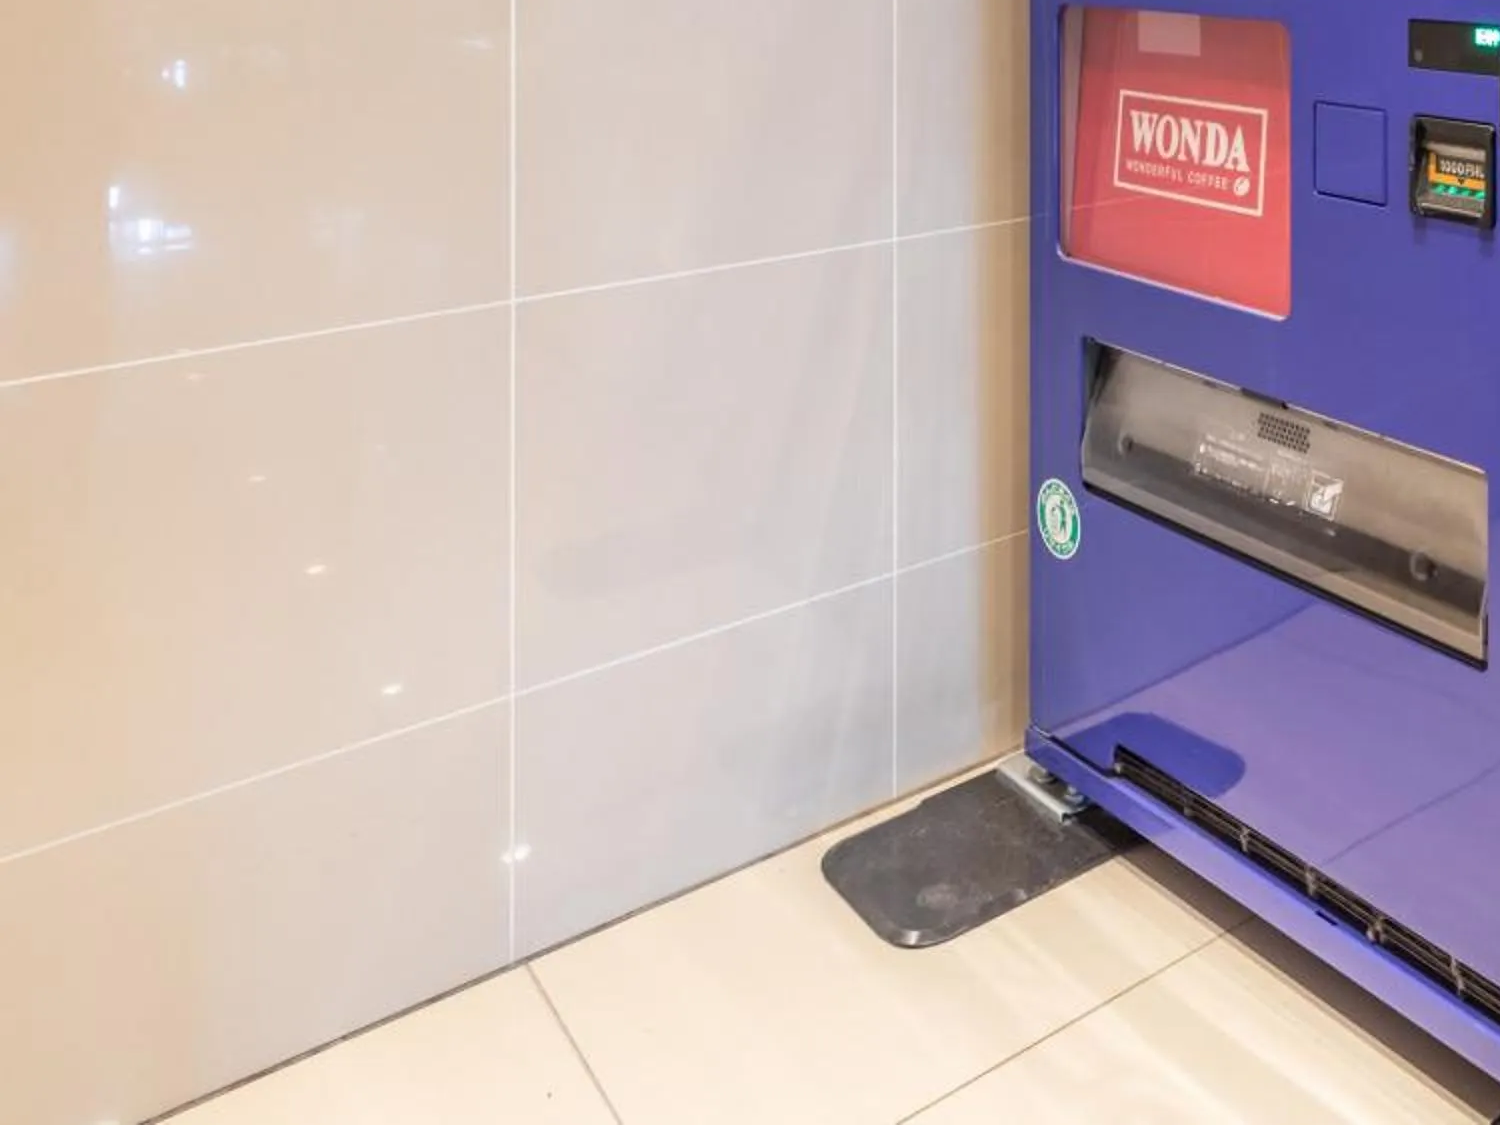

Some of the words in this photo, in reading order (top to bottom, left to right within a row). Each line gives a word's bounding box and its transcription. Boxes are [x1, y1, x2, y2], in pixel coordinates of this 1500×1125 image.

[1129, 109, 1251, 173] WONDA
[1125, 158, 1184, 183] WONDERFUL
[1187, 170, 1229, 191] COFFEE
